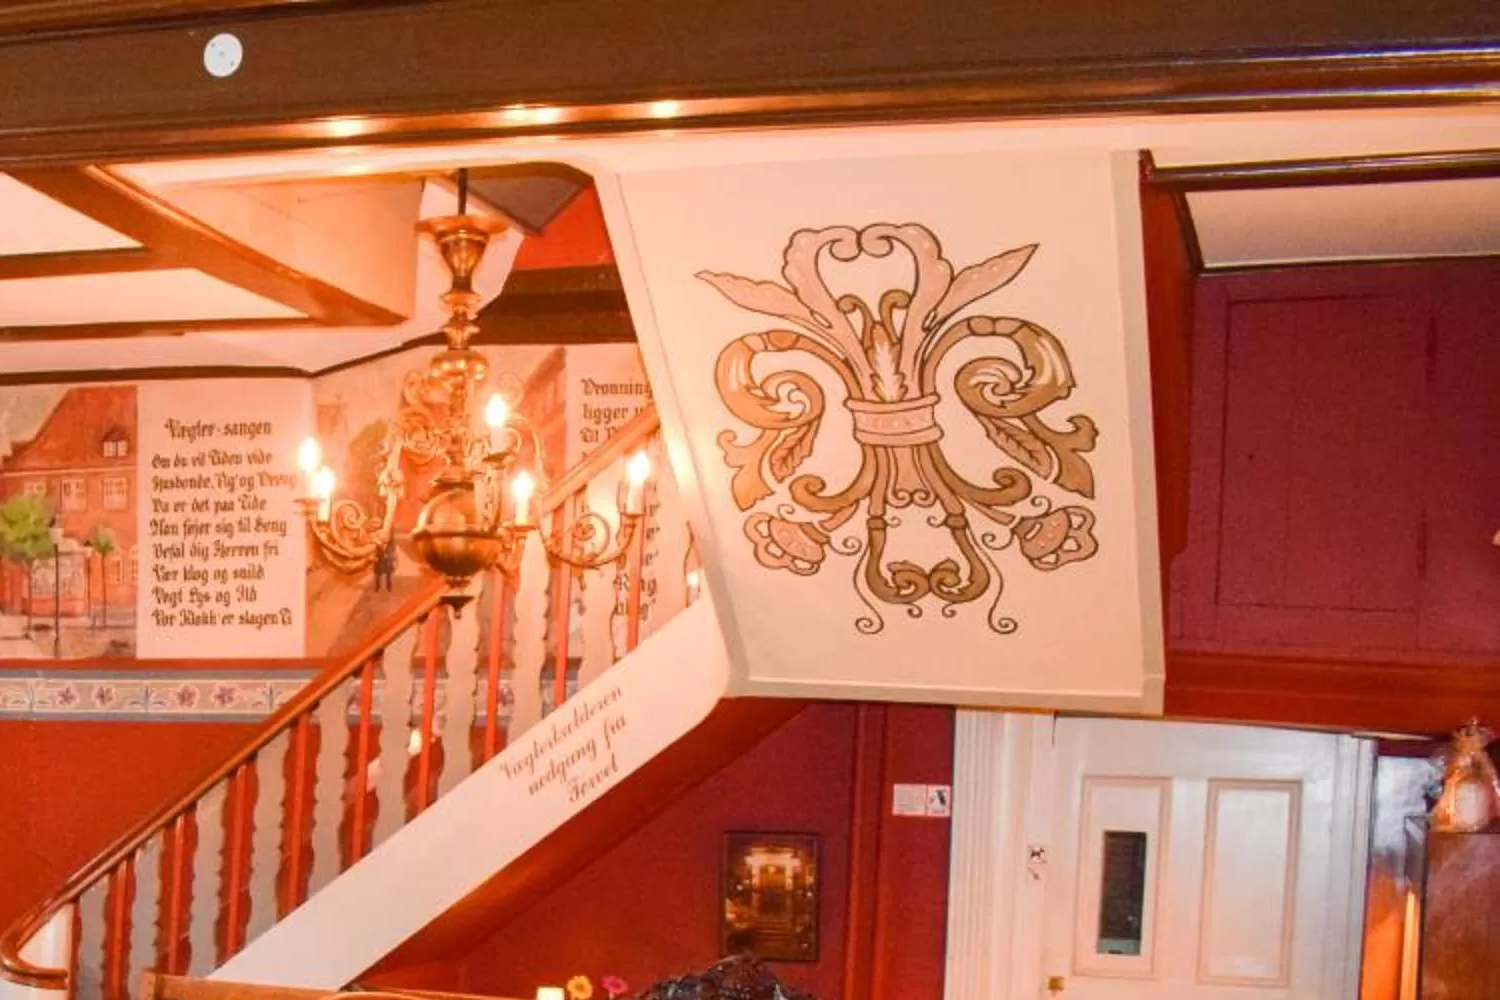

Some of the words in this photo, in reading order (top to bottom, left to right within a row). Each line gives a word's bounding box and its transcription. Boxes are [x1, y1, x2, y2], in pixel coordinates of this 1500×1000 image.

[583, 403, 629, 425] ligger
[173, 451, 188, 468] du
[191, 452, 207, 468] vil
[208, 449, 243, 466] Tiden
[247, 449, 272, 465] vide
[240, 476, 255, 492] og
[173, 502, 187, 513] er
[191, 498, 210, 513] det
[214, 501, 235, 515] paa
[238, 494, 267, 512] Tide
[215, 520, 234, 539] sig
[238, 518, 251, 533] til
[190, 541, 209, 561] dig
[263, 540, 279, 561] fri
[183, 563, 208, 585] klog
[213, 568, 229, 585] og
[232, 563, 264, 581] snild
[215, 590, 230, 607] og
[221, 613, 235, 625] er
[238, 611, 278, 630] slagen
[528, 737, 598, 796] nedgang
[603, 714, 627, 750] fra
